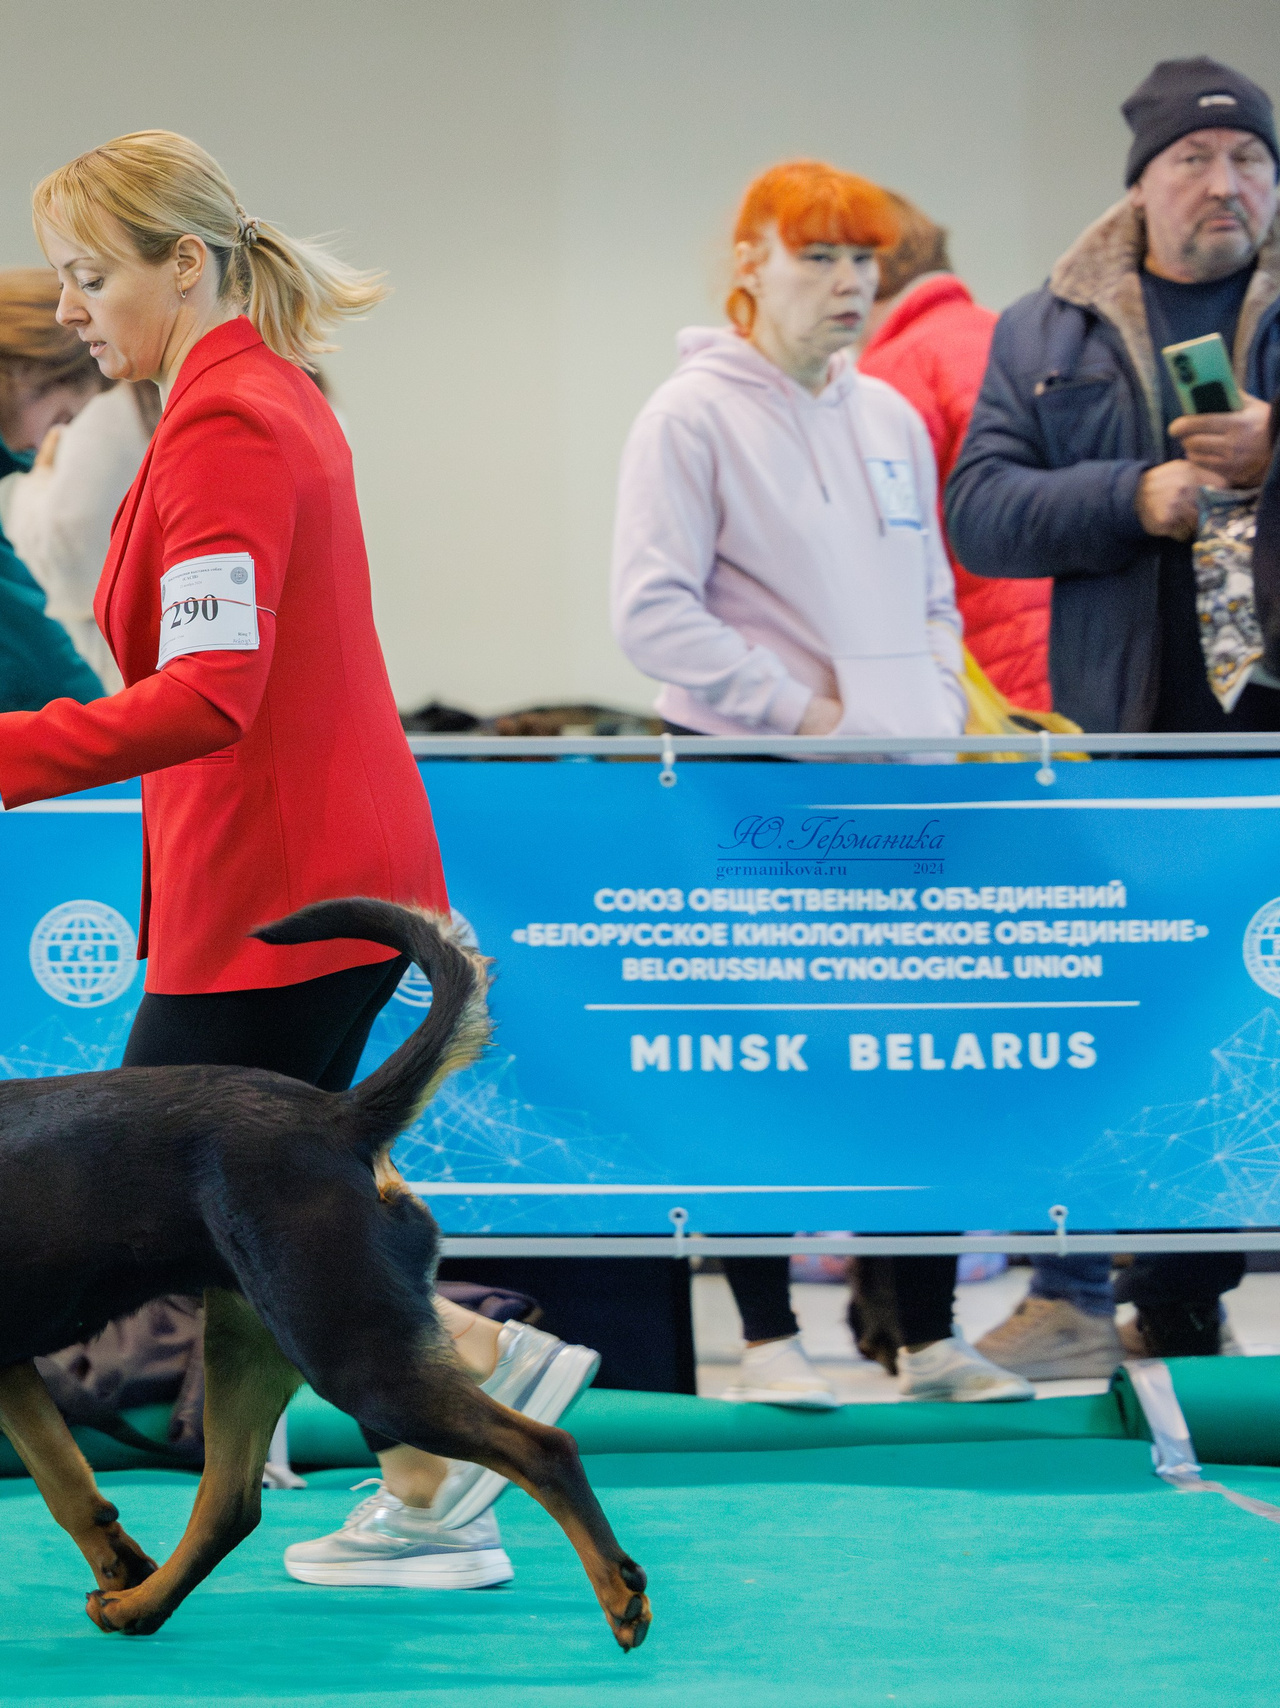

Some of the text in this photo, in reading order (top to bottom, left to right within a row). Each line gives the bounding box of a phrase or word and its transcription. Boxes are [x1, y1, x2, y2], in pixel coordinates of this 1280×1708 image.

[170, 594, 219, 630] 290
[593, 879, 1127, 916] СОЮЗ ОБЩЕСТВЕННЫХ ОБЪЕДИНЕНИЙ
[510, 918, 1210, 948] «БЕЛОРУССКОЕ КИНОЛОГИЧЕСКОЕ ОБЪЕДИНЕНИЕ»
[621, 953, 1104, 981] BELORUSSIAN CYNOLOGICAL UNION
[630, 1030, 1098, 1073] MINSK BELARUS
